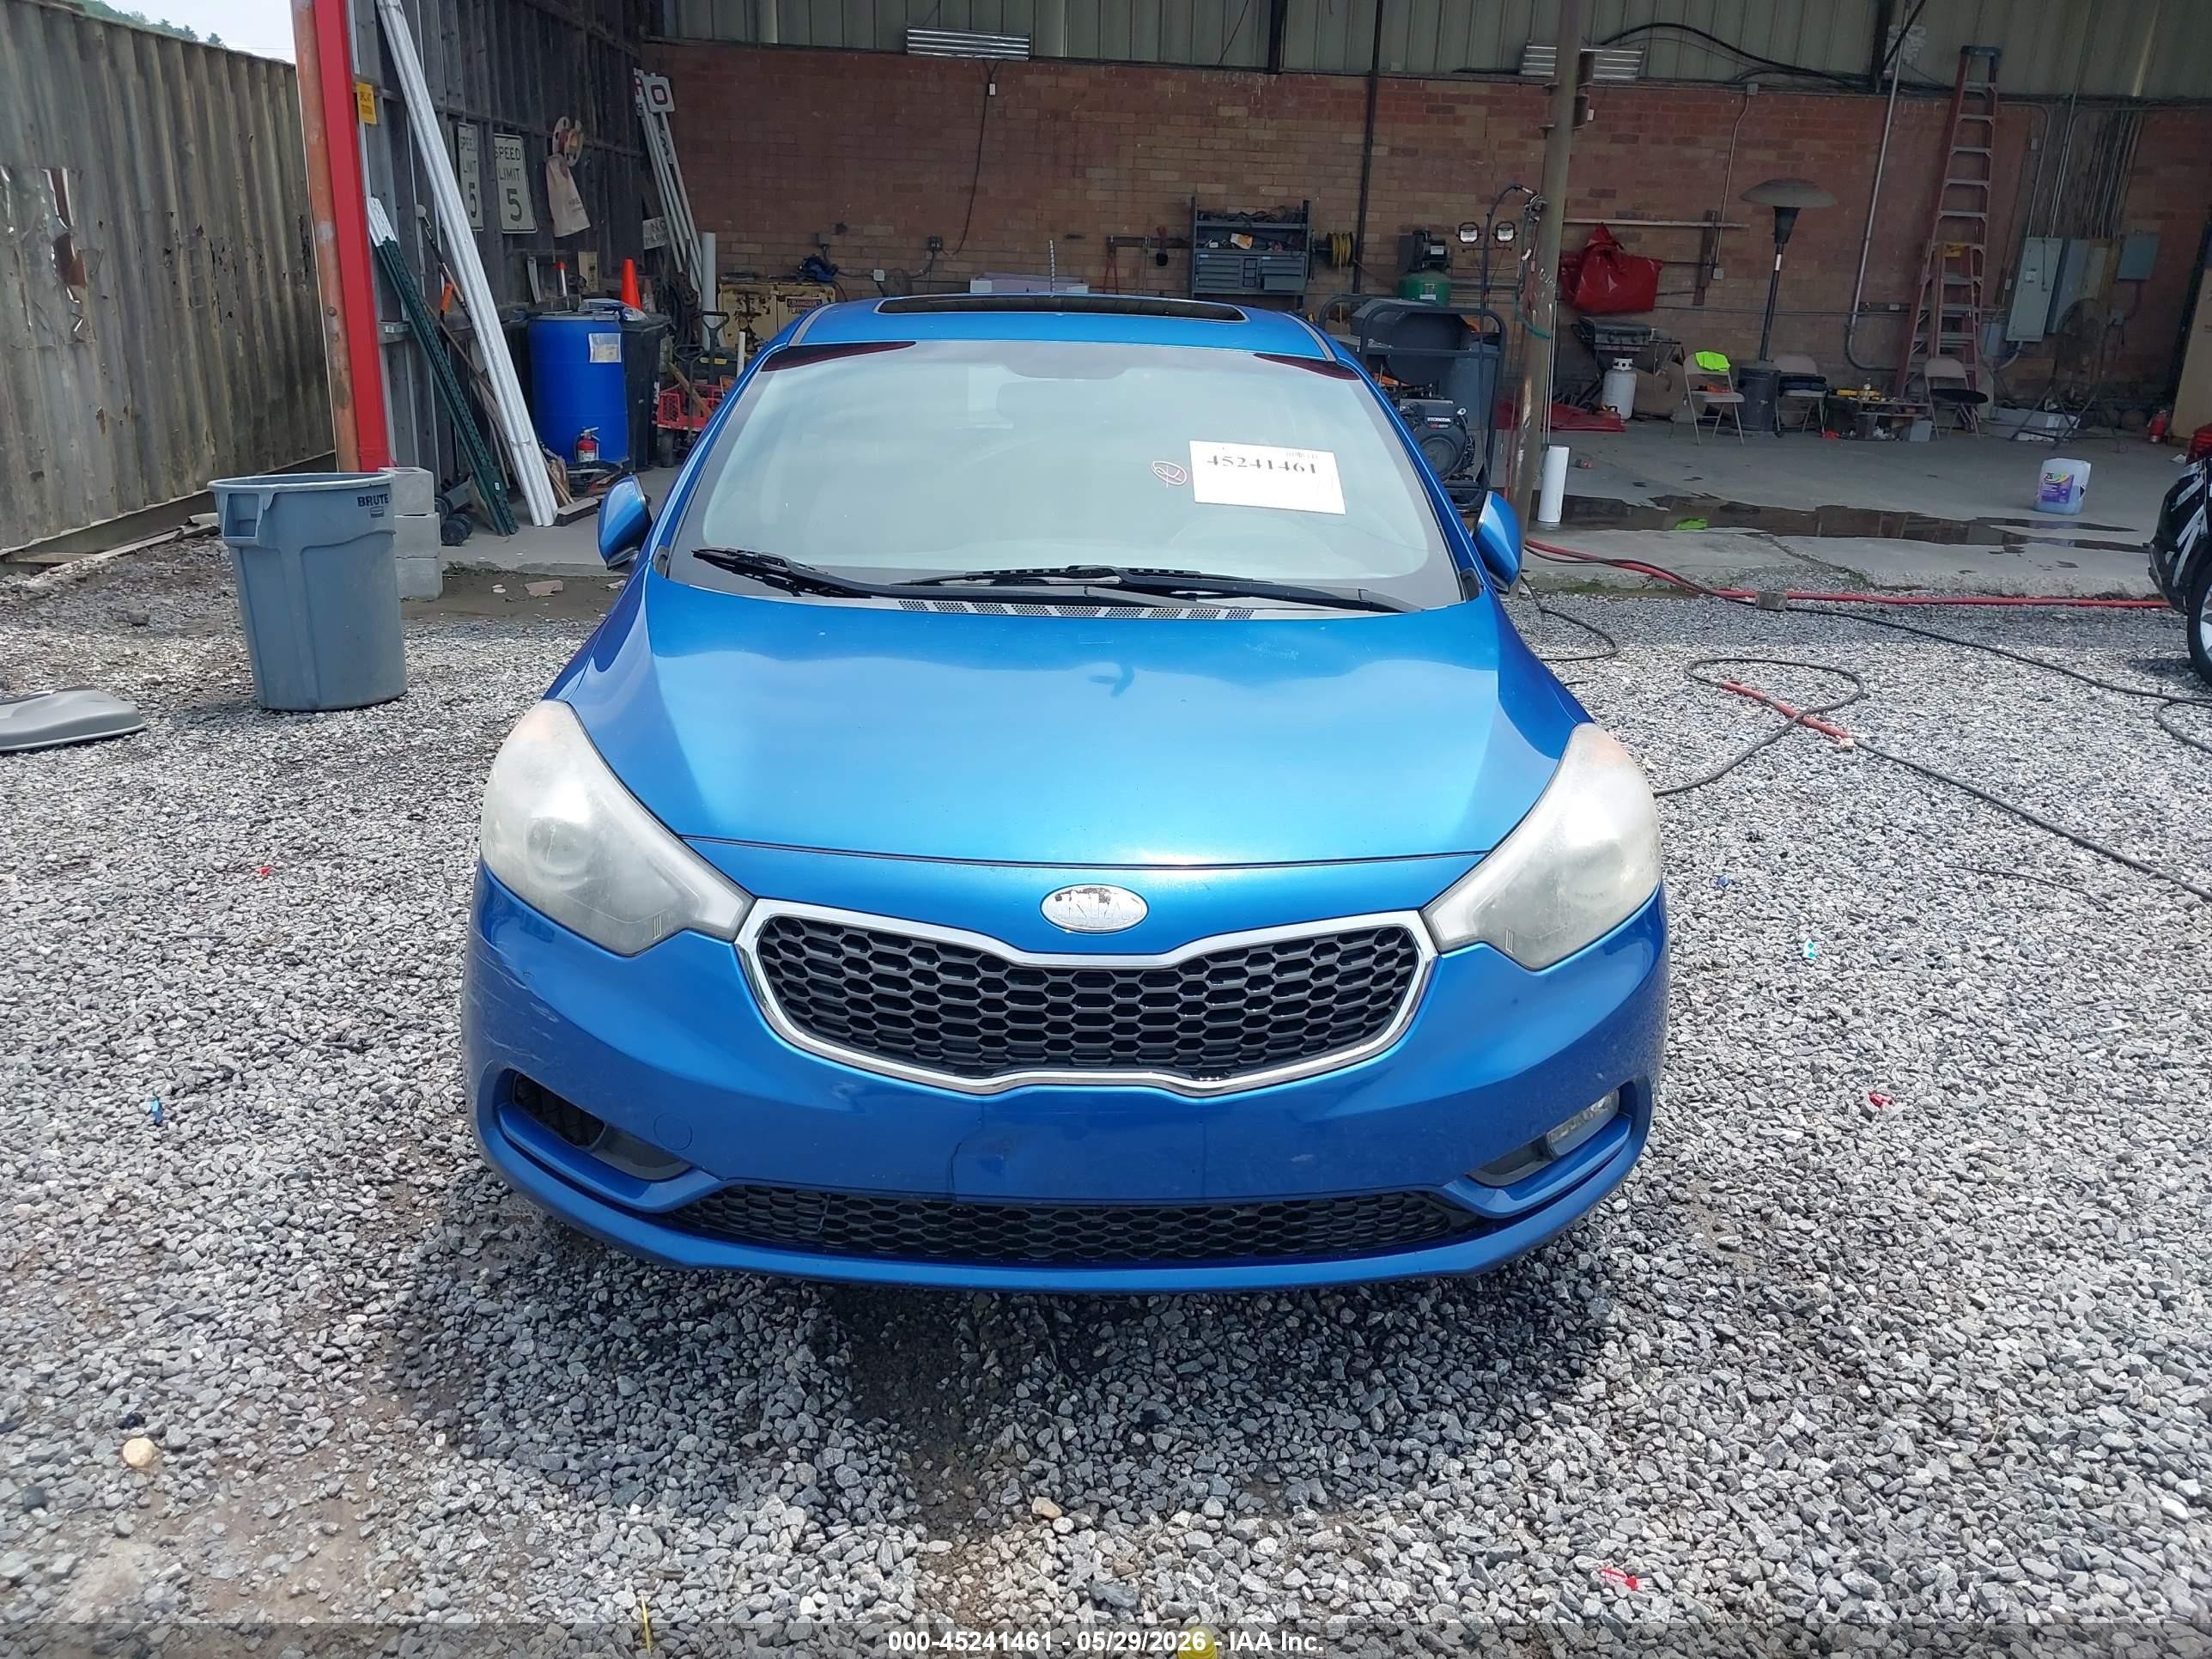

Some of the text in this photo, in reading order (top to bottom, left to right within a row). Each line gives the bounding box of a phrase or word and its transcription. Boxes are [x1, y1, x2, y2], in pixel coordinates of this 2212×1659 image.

[495, 146, 521, 161] SPEED
[499, 167, 520, 181] LIMIT
[468, 182, 477, 218] 5
[507, 188, 523, 222] 5
[1207, 455, 1316, 473] 45241461
[357, 494, 389, 507] BRUTE
